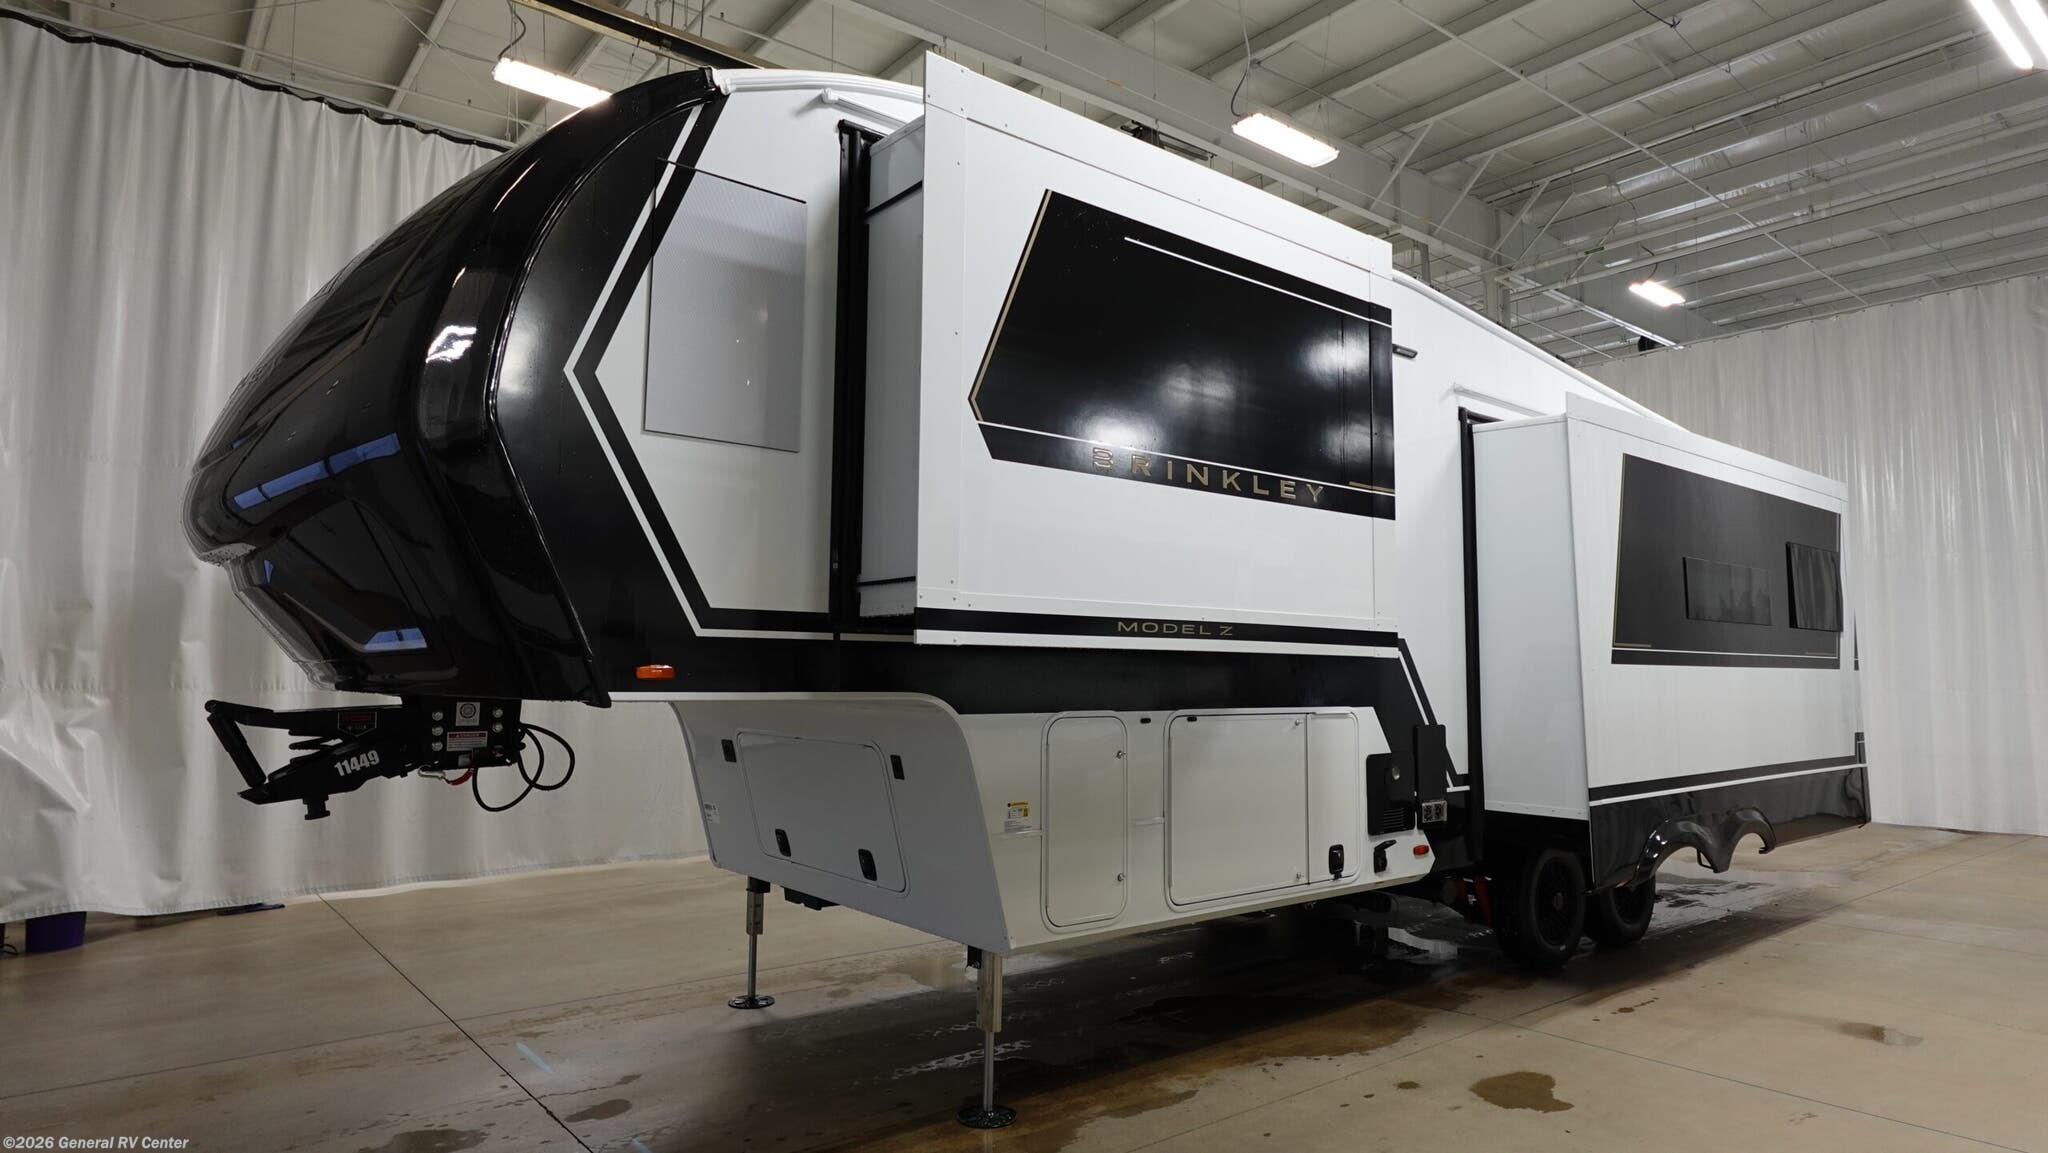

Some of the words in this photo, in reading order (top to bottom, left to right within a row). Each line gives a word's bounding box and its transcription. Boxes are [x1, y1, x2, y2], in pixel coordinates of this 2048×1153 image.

[1092, 447, 1324, 503] BRINKLEY
[1118, 621, 1211, 635] MODEL
[1219, 626, 1233, 636] Z
[334, 750, 379, 776] 11449
